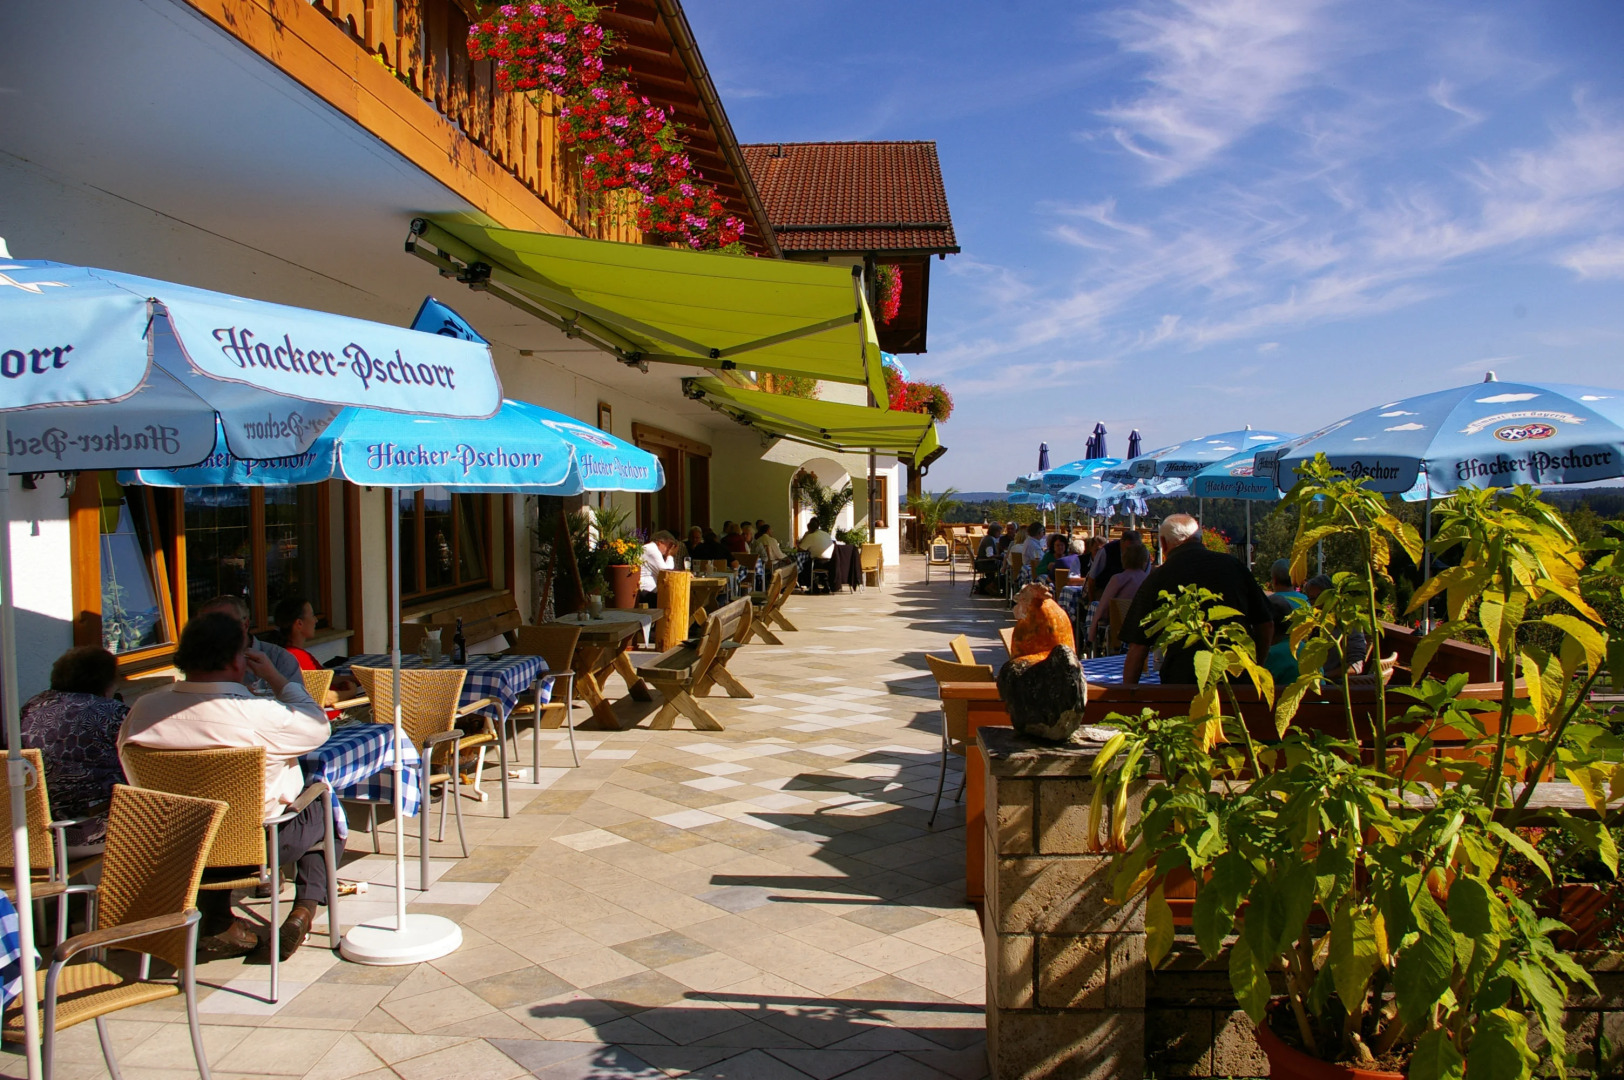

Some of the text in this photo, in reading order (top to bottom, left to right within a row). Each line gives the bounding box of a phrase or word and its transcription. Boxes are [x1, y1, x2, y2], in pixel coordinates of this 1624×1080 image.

[212, 326, 455, 390] Hacker-Pschorr
[367, 442, 543, 477] Hacker-Pschorr
[1456, 449, 1612, 481] Hacker-Pschorr
[1204, 480, 1268, 495] Hacker-Pschorr
